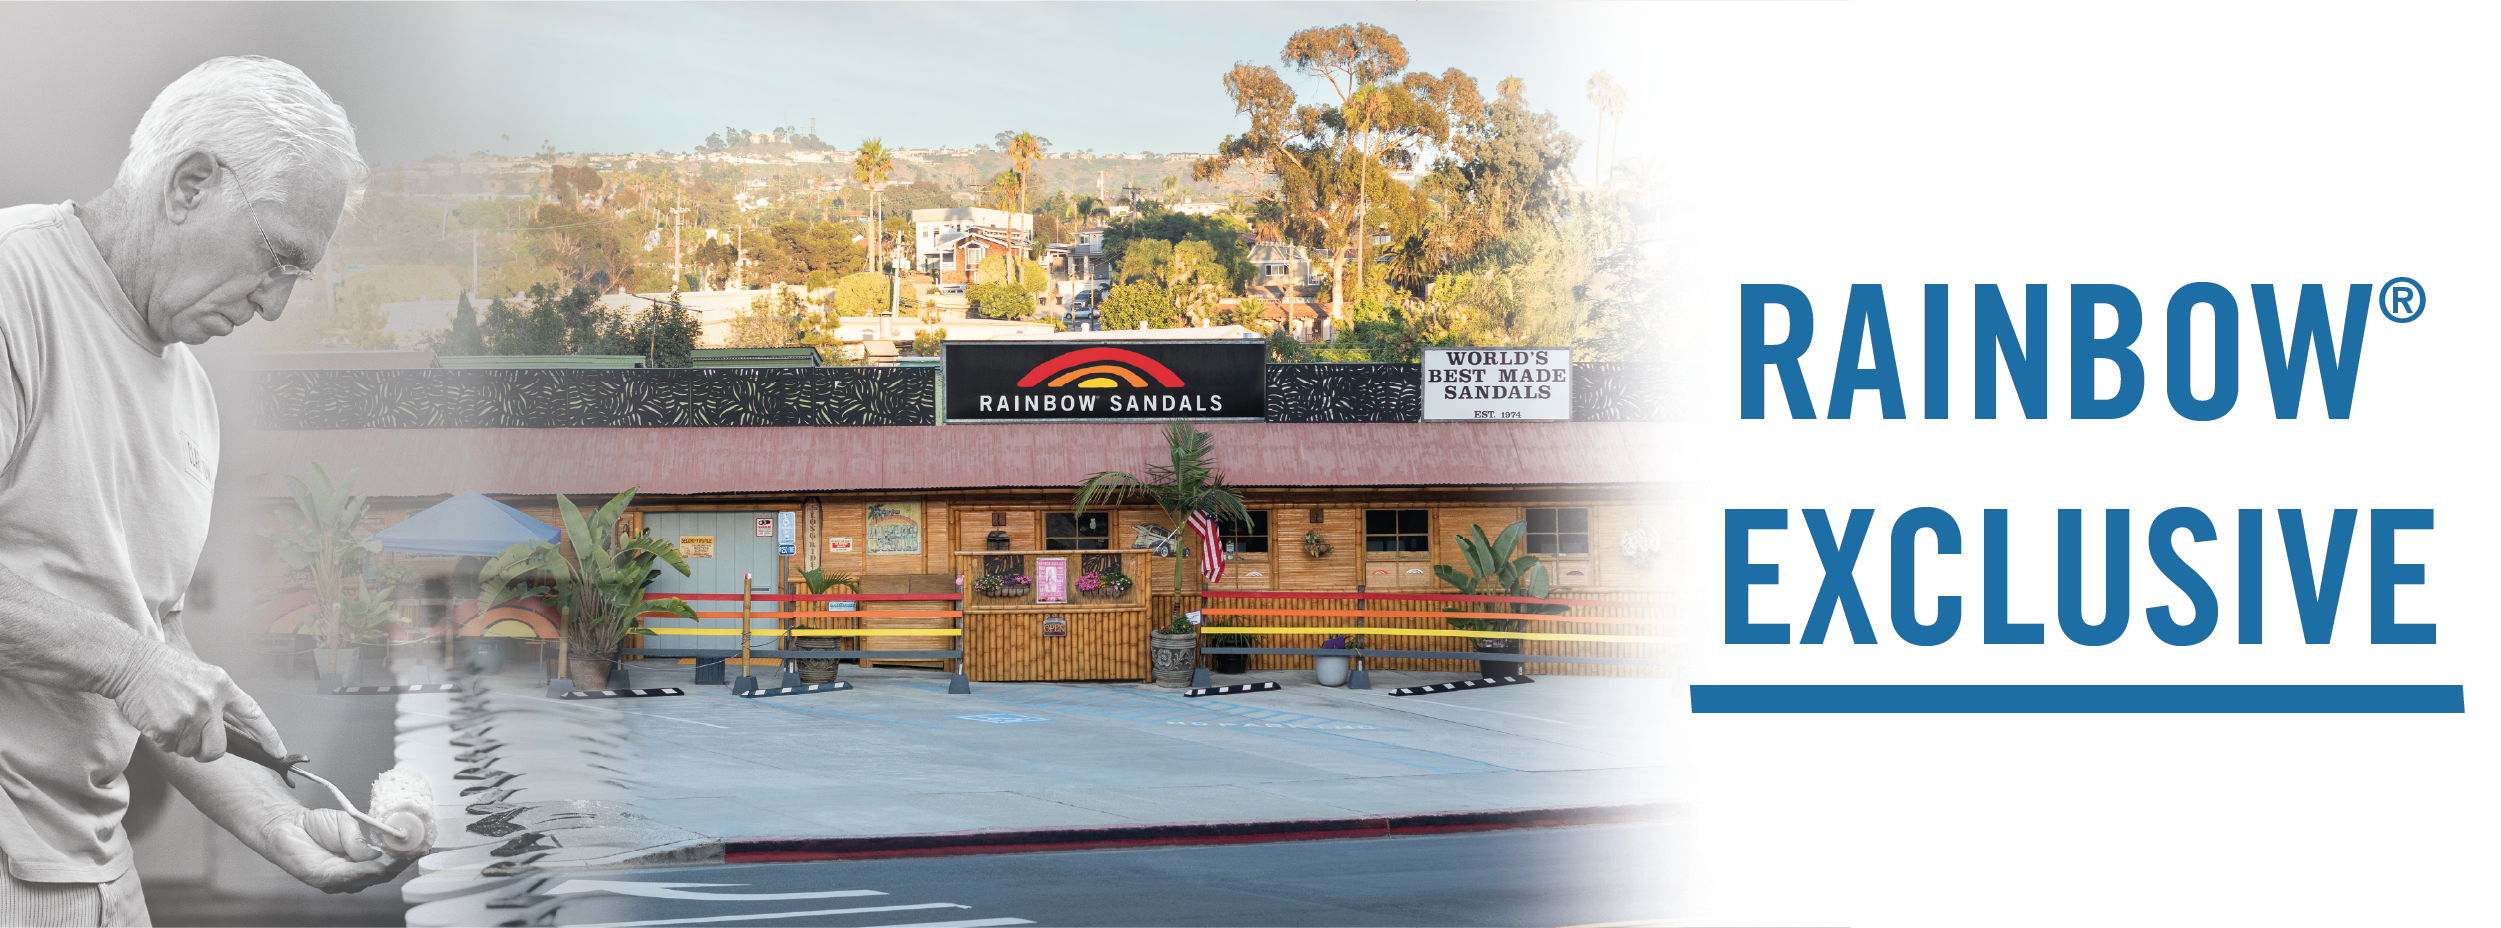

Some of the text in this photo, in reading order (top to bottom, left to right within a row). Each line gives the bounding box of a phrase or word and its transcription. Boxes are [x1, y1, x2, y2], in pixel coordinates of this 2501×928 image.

[1446, 351, 1549, 366] WORLD'S
[1428, 369, 1566, 383] BEST MADE
[1444, 385, 1551, 400] SANDALS
[1109, 394, 1223, 412] SANDALS
[1473, 410, 1522, 419] EST. 1974
[1044, 624, 1066, 633] OPEN
[1218, 722, 1376, 730] PARKING
